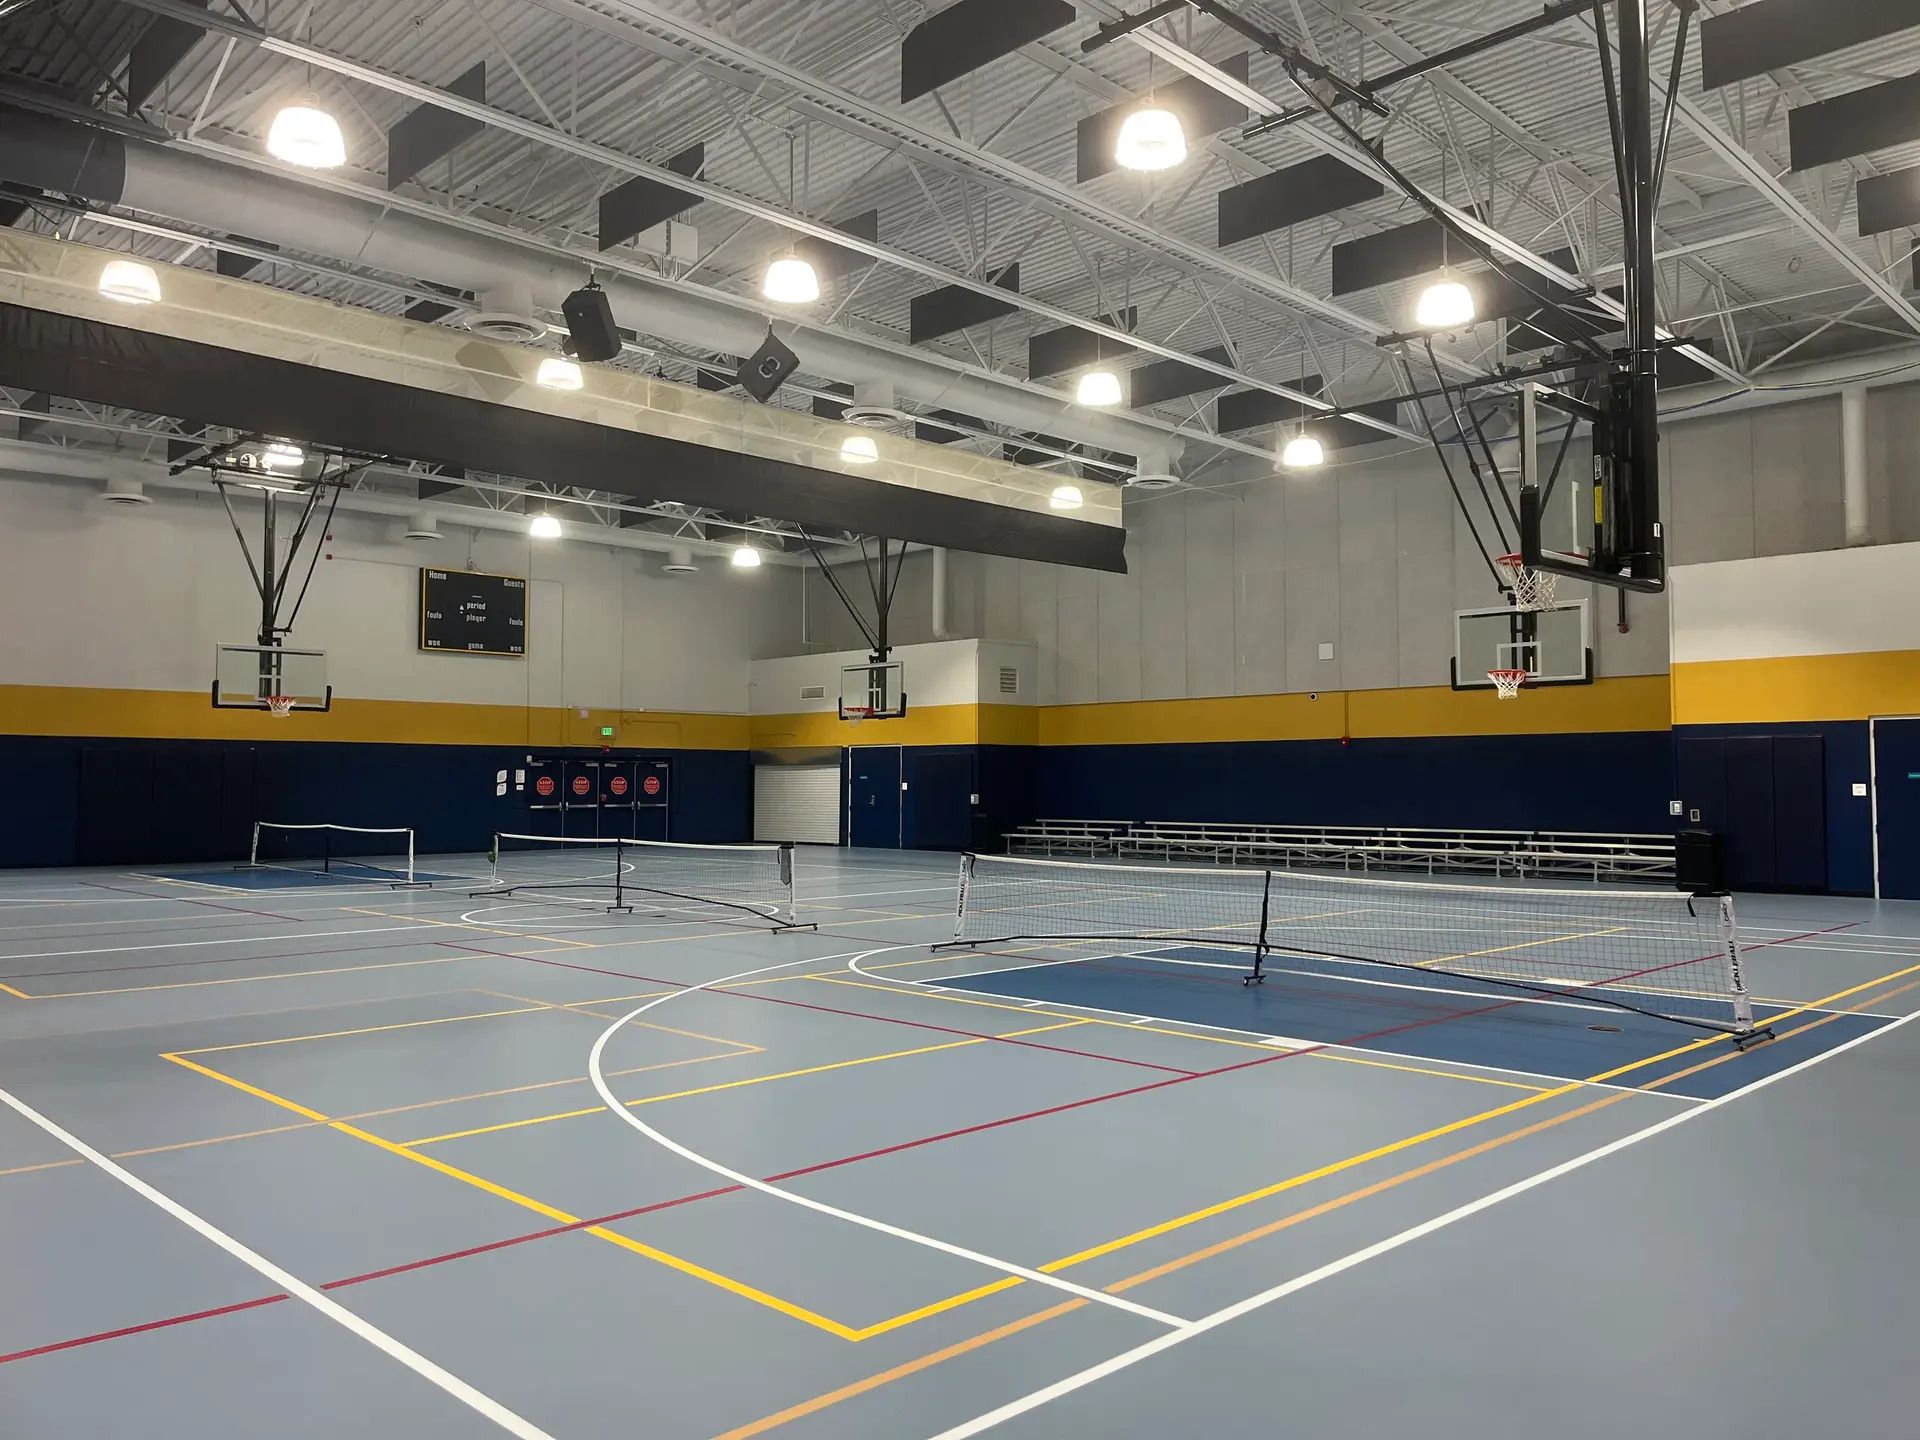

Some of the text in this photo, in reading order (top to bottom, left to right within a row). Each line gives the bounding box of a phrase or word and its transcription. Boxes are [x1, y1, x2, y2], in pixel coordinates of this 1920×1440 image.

[429, 571, 447, 580] Home
[503, 579, 524, 588] Guests
[466, 602, 486, 610] period
[427, 611, 443, 619] fouls
[466, 614, 487, 622] player
[509, 618, 523, 626] fouls
[1728, 940, 1742, 991] PICKLEBALL
